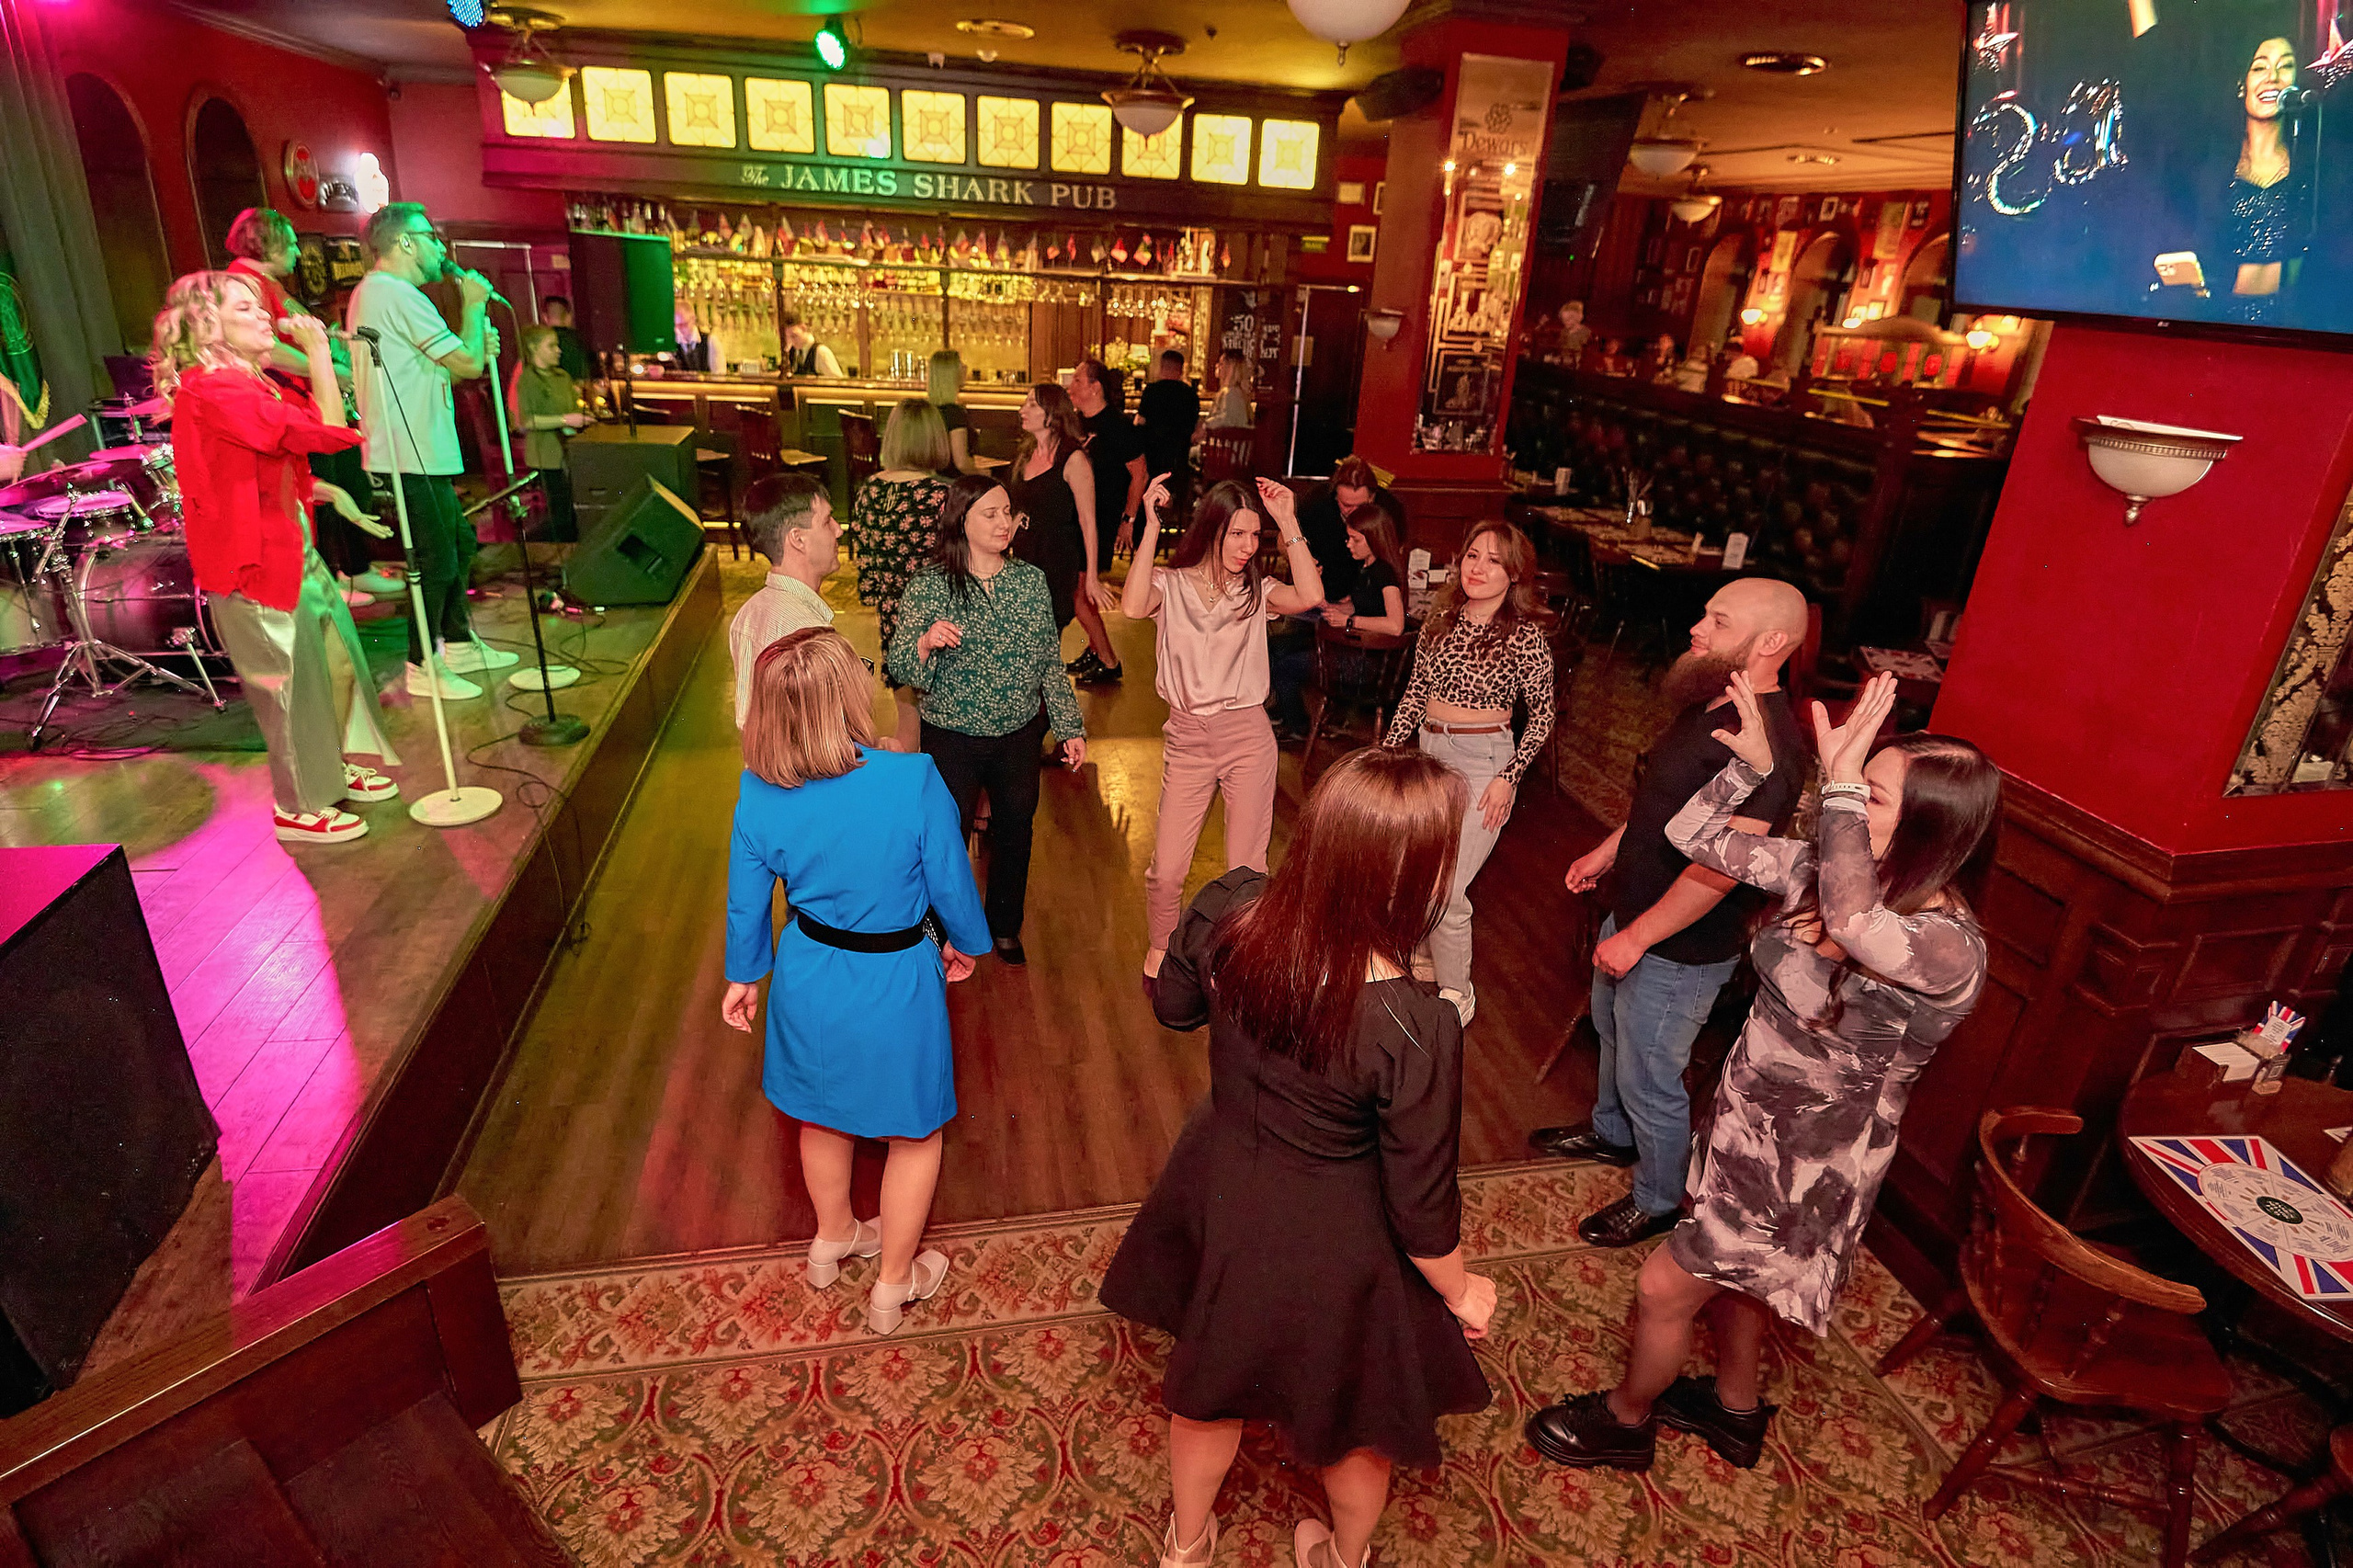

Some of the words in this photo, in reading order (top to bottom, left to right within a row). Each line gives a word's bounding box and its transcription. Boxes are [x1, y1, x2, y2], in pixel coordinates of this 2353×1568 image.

[741, 165, 769, 187] The
[781, 165, 897, 197] JAMES
[914, 173, 1034, 205] SHARK
[1051, 183, 1117, 210] PUB
